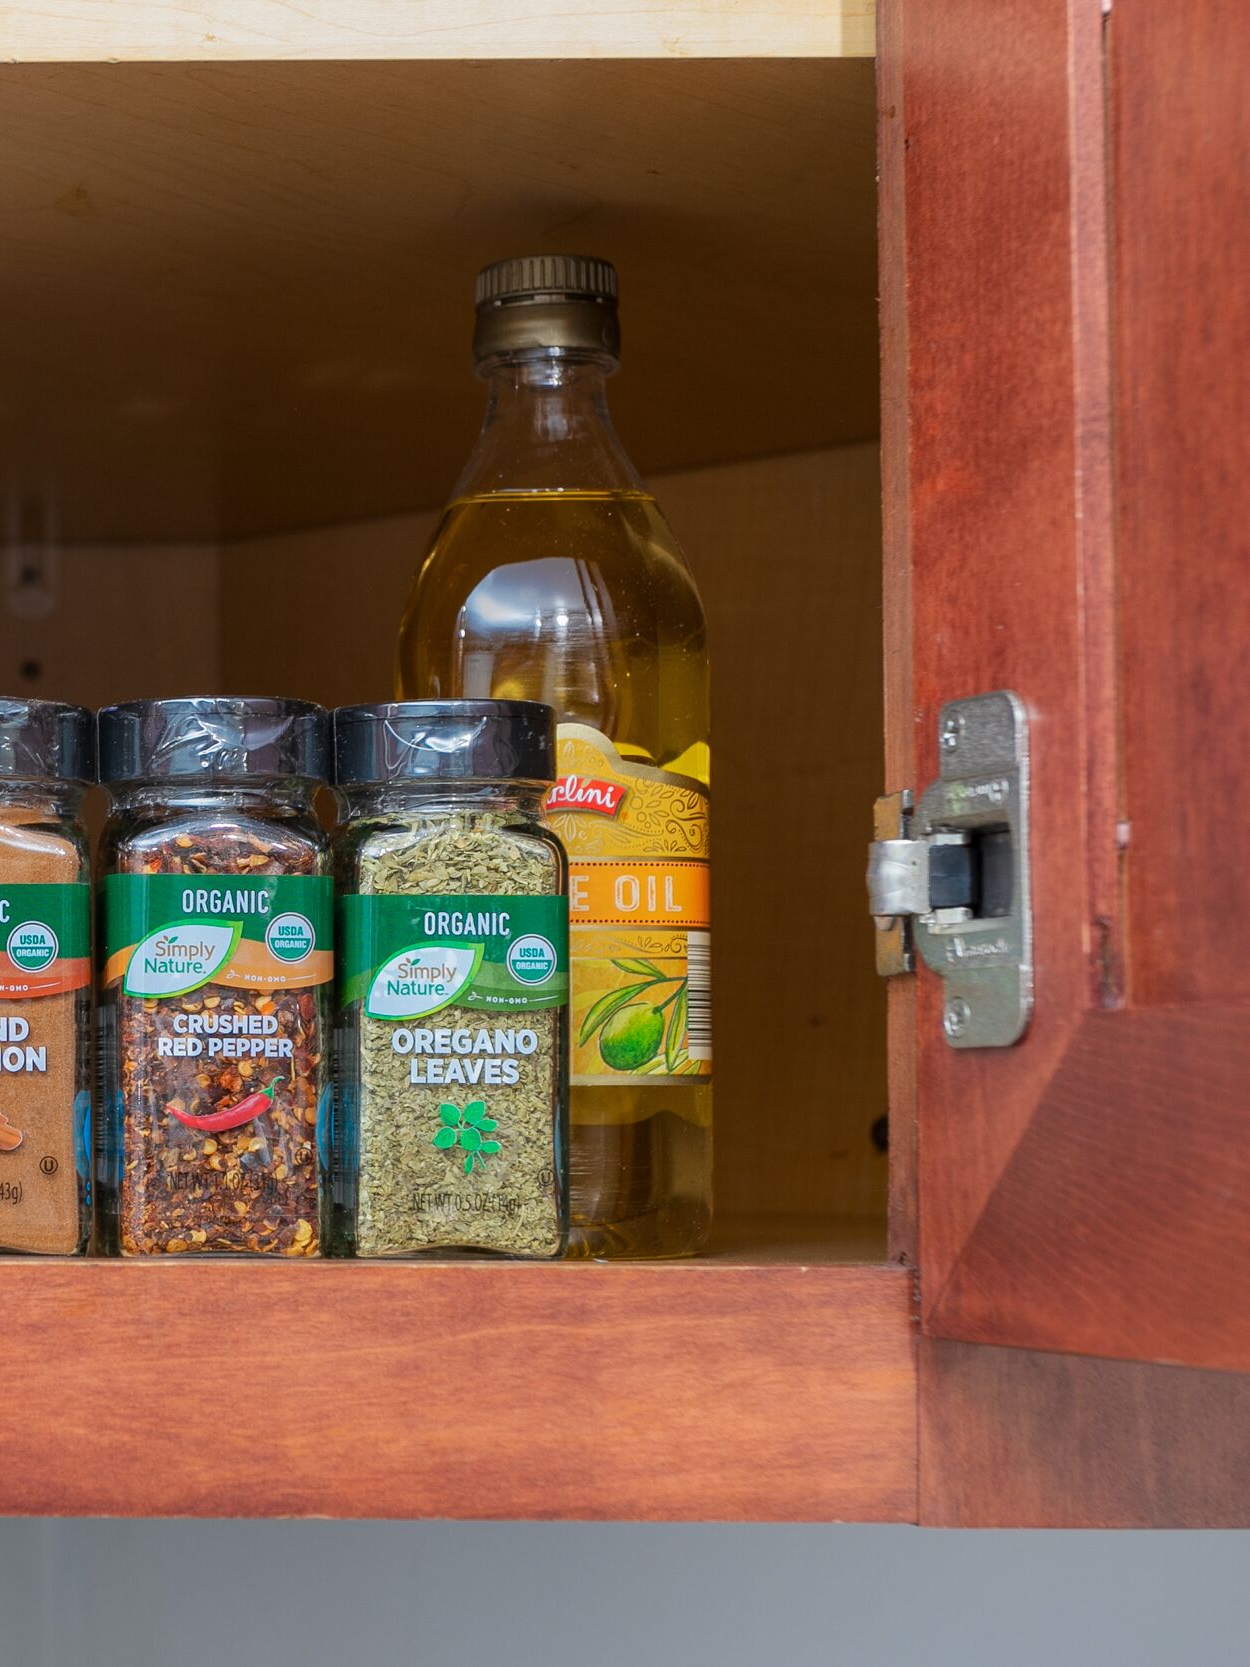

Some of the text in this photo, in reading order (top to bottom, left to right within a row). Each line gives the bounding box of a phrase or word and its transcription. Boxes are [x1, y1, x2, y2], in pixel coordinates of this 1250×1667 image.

[546, 774, 616, 808] rlini
[182, 890, 269, 914] ORGANIC
[569, 874, 682, 913] E OIL
[278, 926, 304, 936] USDA
[424, 912, 510, 936] ORGANIC
[20, 934, 46, 945] USDA
[274, 940, 307, 950] ORGANIC
[16, 948, 50, 958] ORGANIC
[155, 940, 216, 961] Simply
[519, 948, 545, 958] USDA
[398, 963, 456, 982] Simply
[516, 961, 548, 971] ORGANIC
[486, 996, 528, 1004] NON-GMO
[172, 1014, 278, 1035] CRUSHED
[158, 1038, 294, 1058] RED PEPPER
[392, 1028, 538, 1055] OREGANO
[410, 1058, 520, 1084] LEAVES
[412, 1193, 431, 1212] NET
